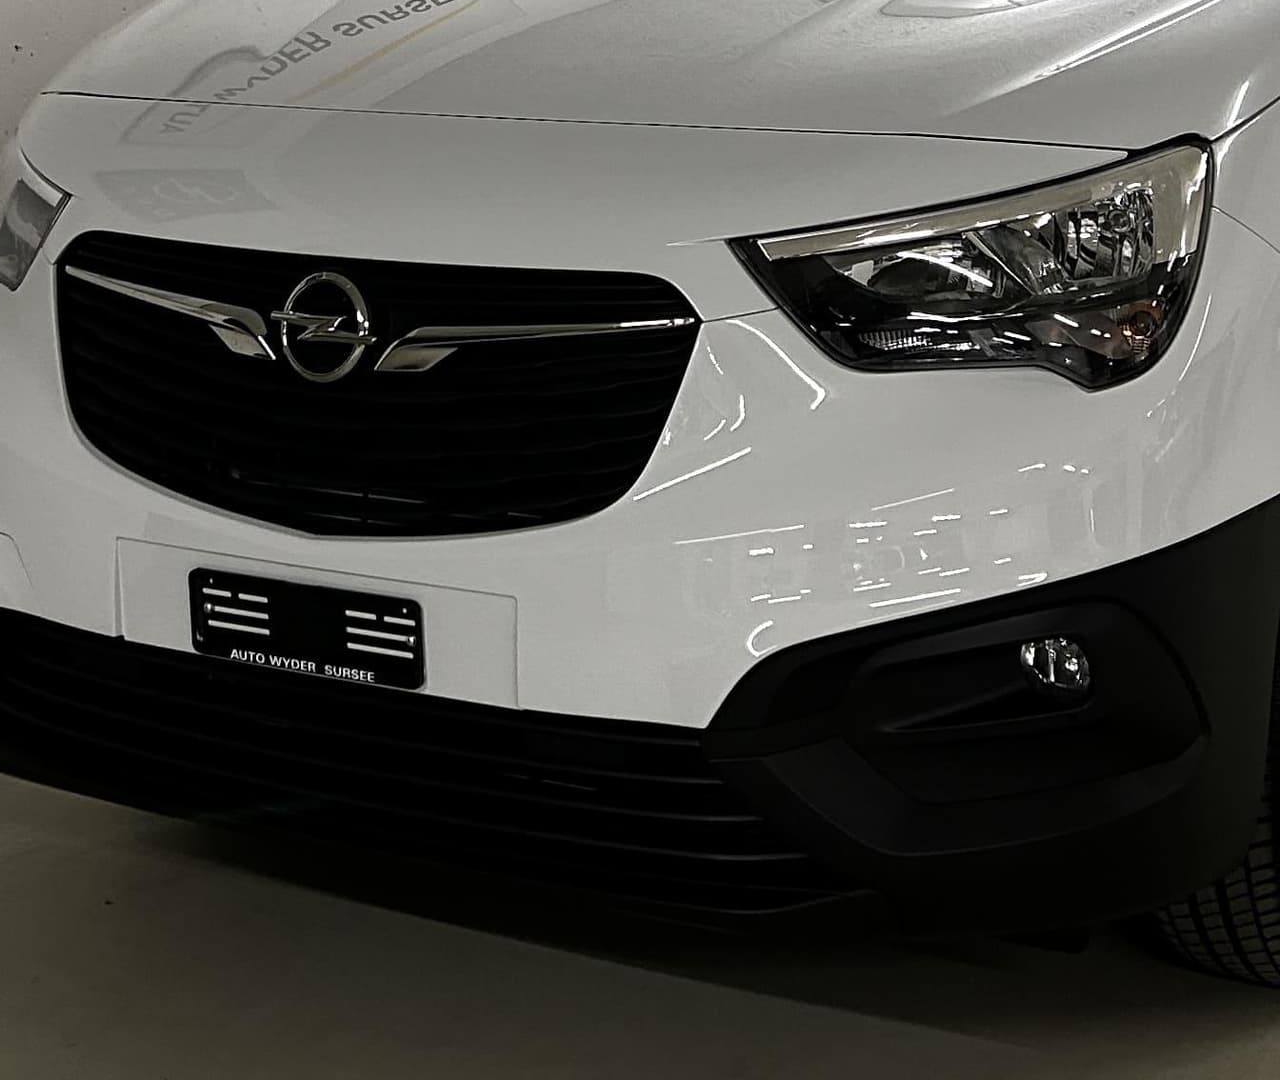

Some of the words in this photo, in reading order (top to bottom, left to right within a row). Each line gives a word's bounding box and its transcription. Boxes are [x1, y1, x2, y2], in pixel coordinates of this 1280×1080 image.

[230, 648, 265, 664] AUTO
[269, 654, 317, 673] WYDER
[324, 664, 376, 683] SURSEE
